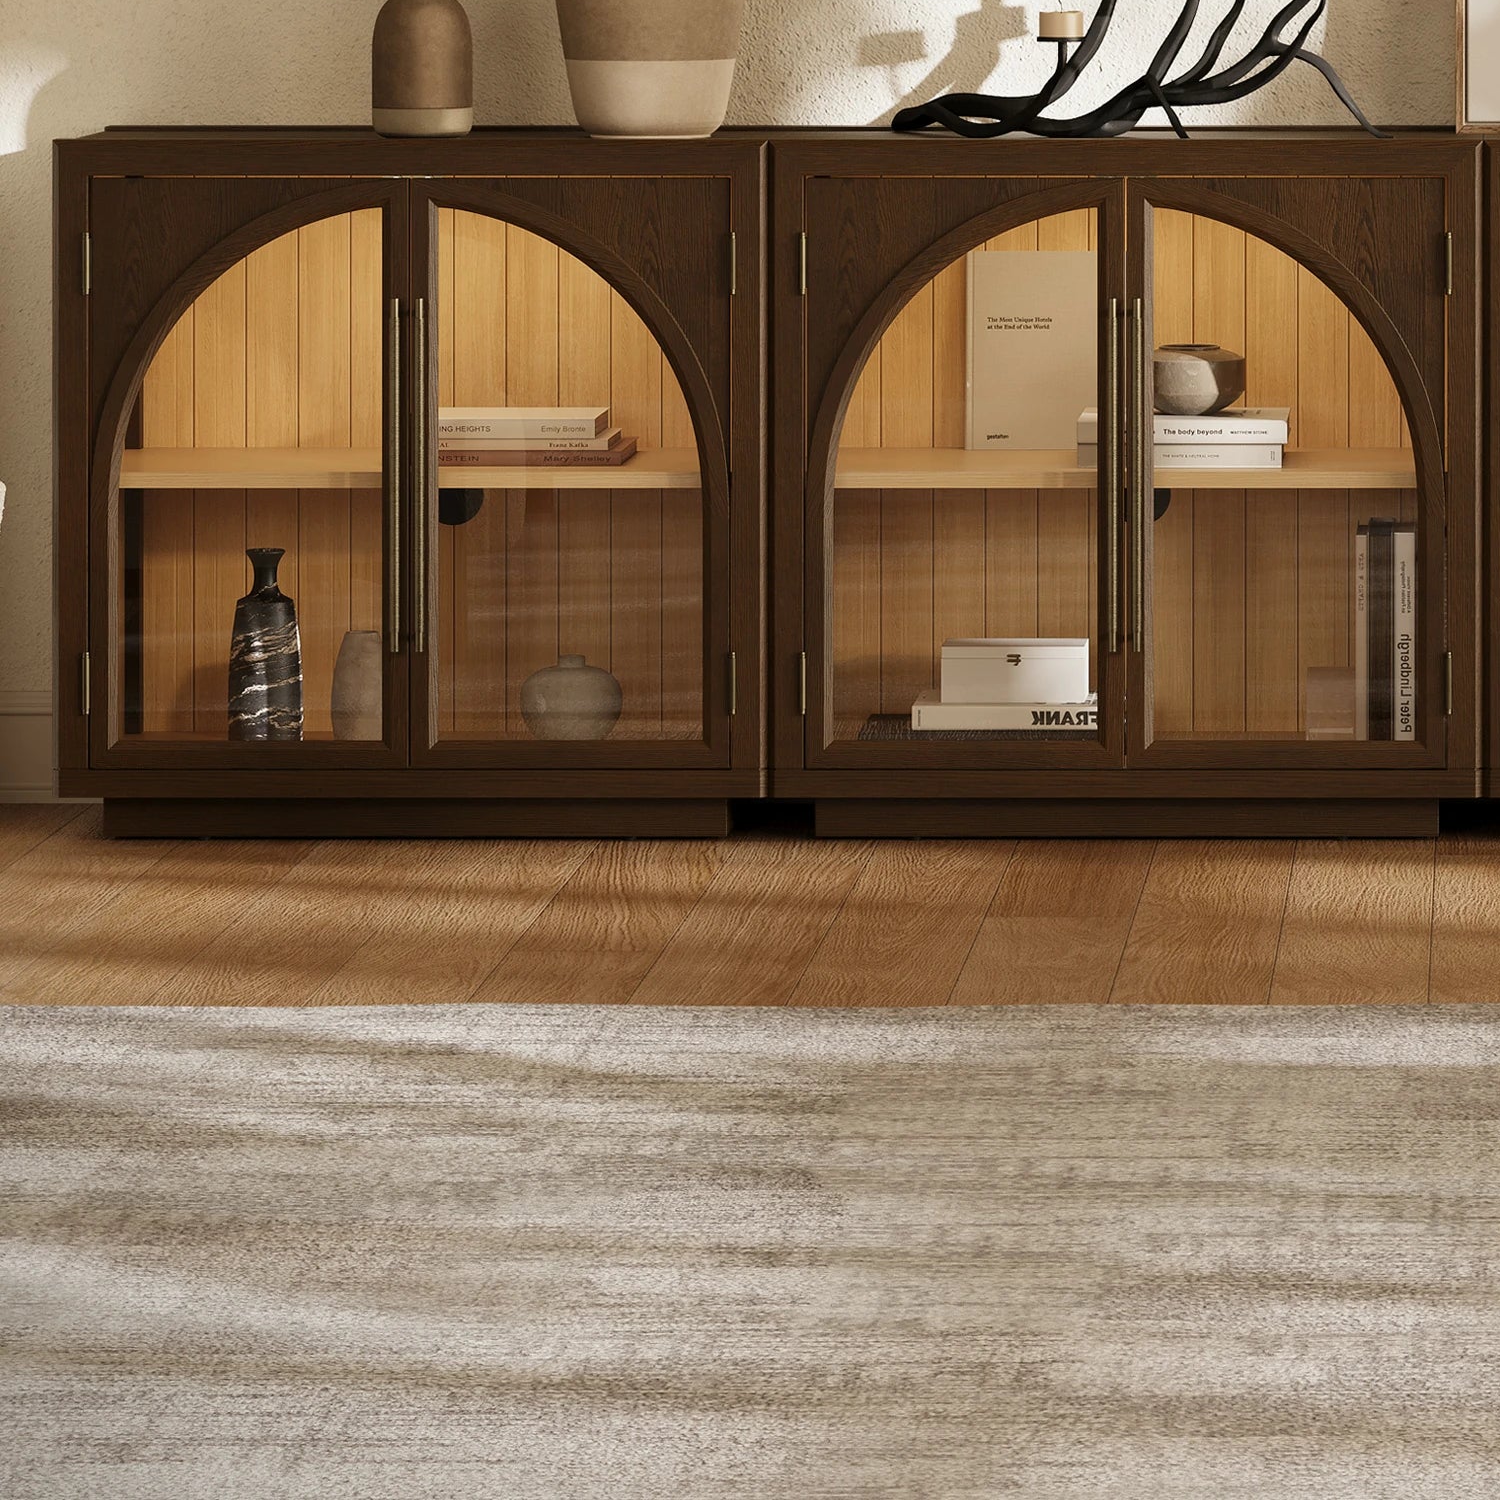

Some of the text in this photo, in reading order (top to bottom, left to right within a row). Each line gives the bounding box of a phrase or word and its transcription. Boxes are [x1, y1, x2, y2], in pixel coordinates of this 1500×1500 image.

[1014, 316, 1034, 324] Unique
[455, 425, 491, 433] HEIGHTS
[541, 425, 561, 434] Emily
[1177, 428, 1195, 436] body
[1196, 428, 1223, 436] beyond
